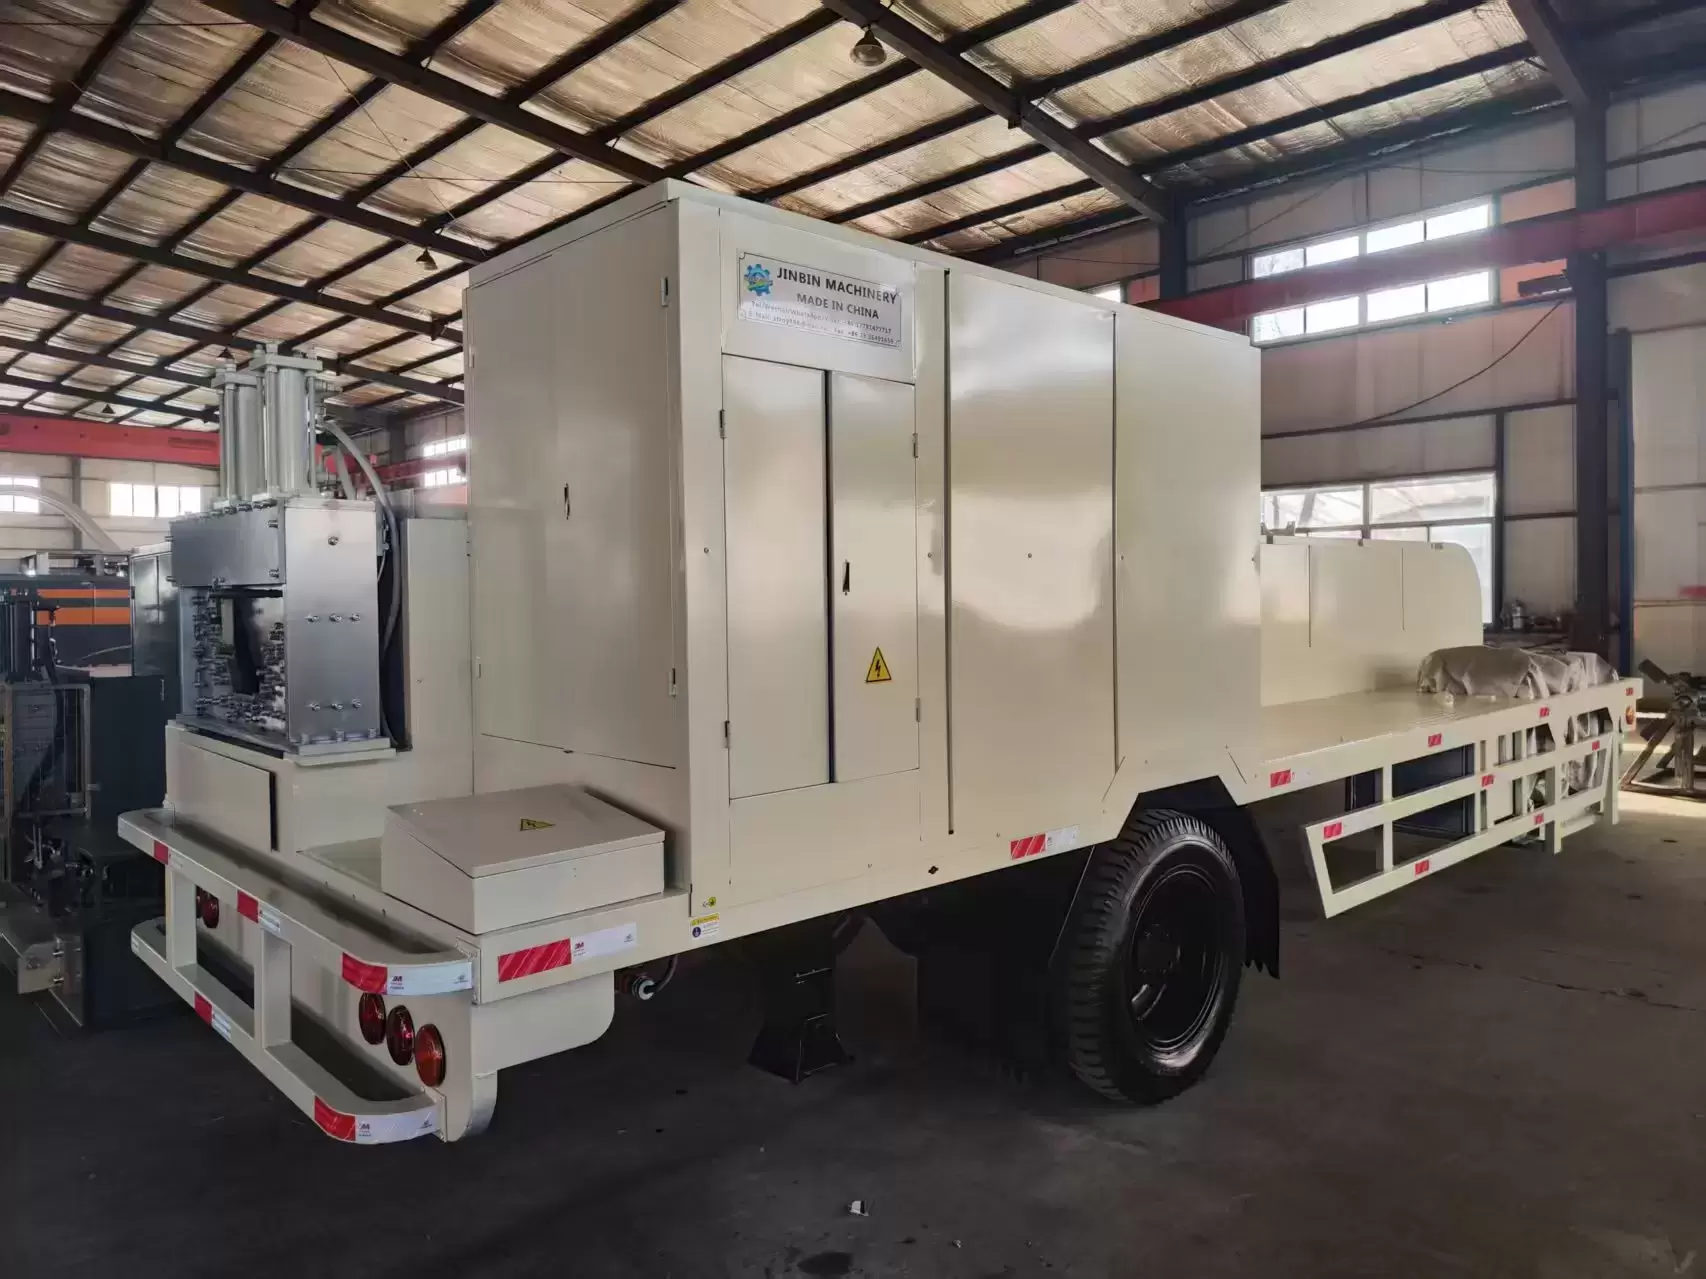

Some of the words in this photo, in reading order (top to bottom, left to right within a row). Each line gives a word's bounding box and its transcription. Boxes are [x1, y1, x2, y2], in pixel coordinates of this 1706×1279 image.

[776, 267, 821, 287] JINBIN
[825, 278, 898, 304] MACHINERY
[796, 293, 829, 309] MADE
[831, 300, 844, 312] IN
[847, 304, 880, 319] CHINA
